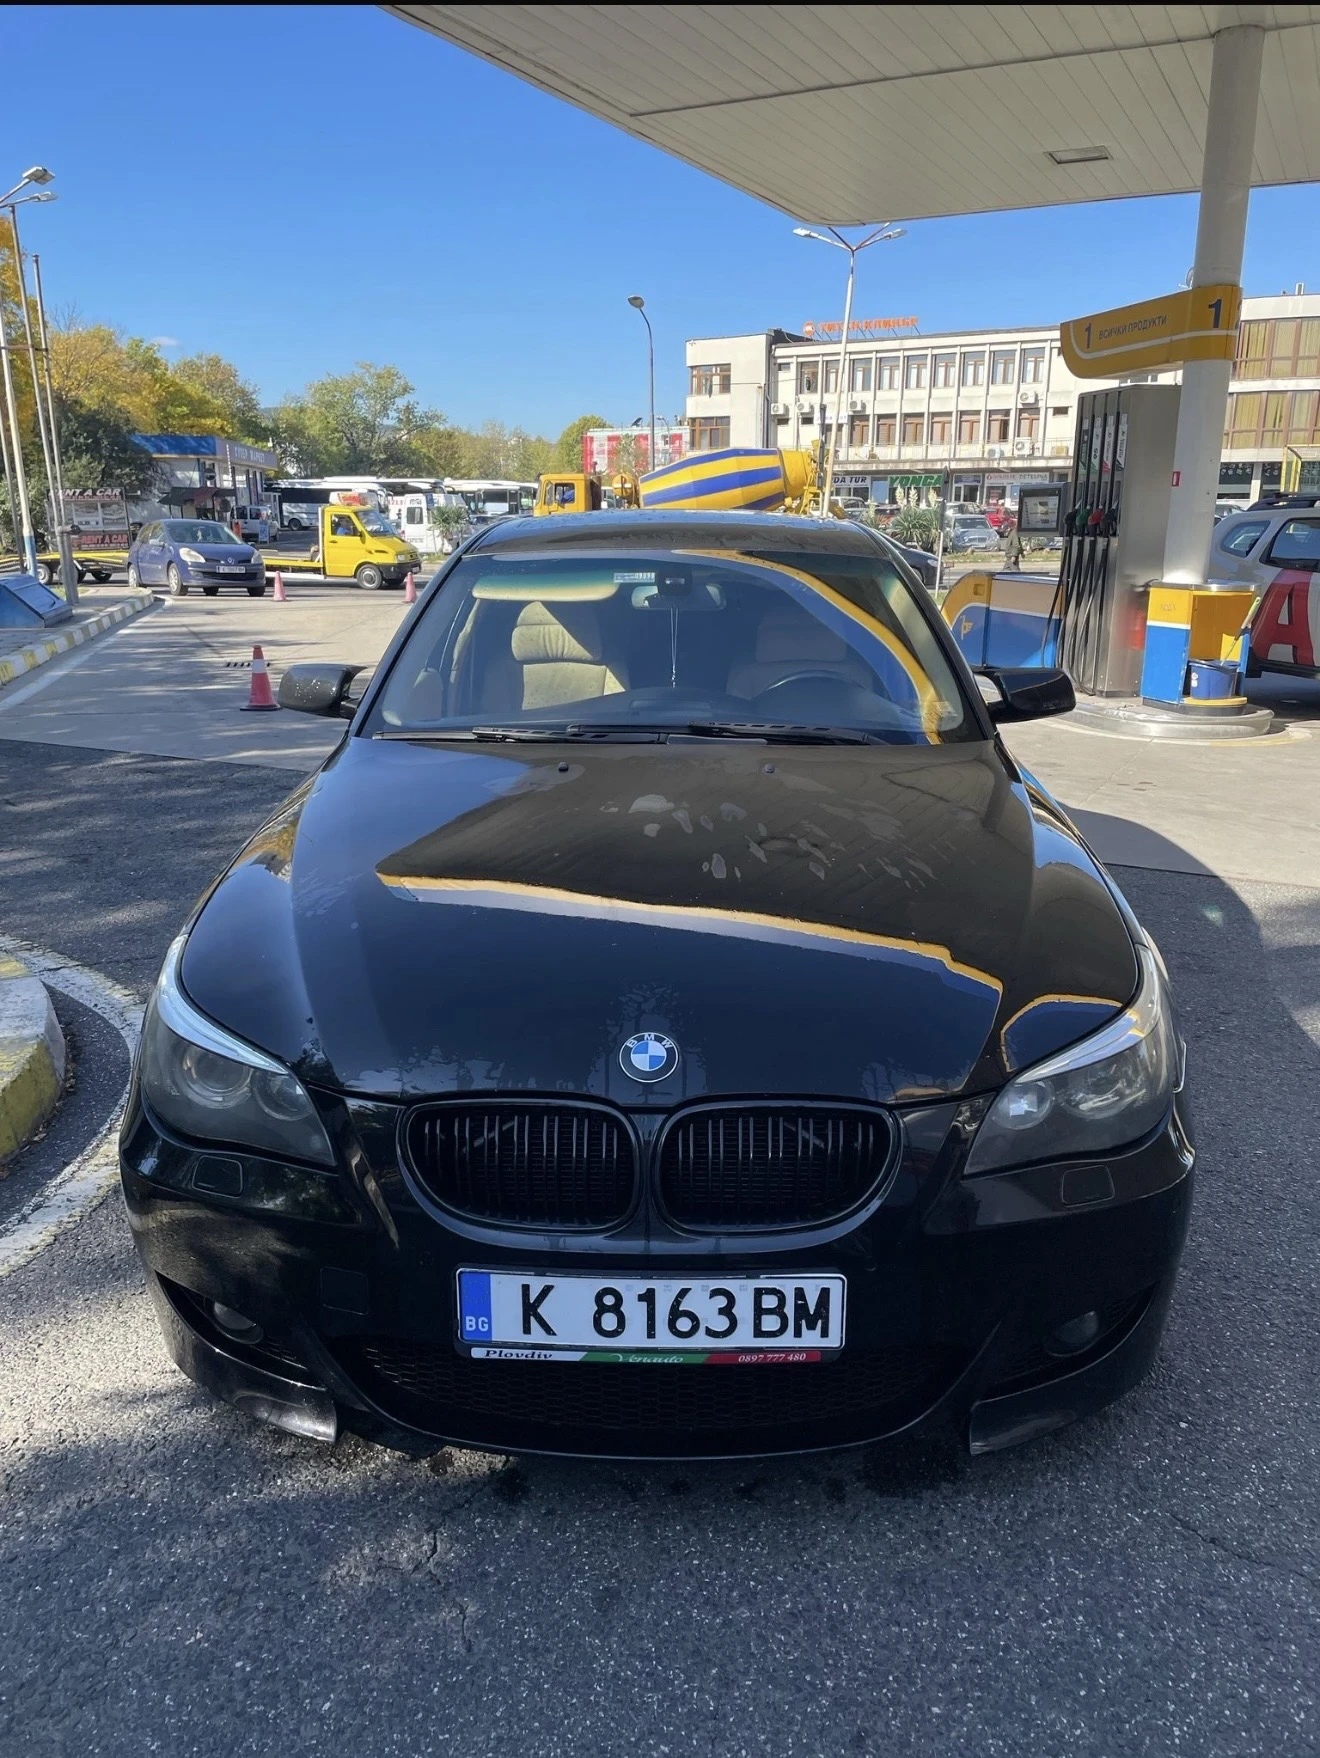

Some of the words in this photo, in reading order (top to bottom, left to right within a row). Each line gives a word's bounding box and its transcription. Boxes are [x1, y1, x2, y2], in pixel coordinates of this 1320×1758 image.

[1208, 298, 1222, 329] 1
[1084, 322, 1092, 349] 1
[1099, 325, 1127, 340] ВСИЧКИ
[1127, 314, 1168, 335] ПРОДУКТИ
[849, 476, 868, 484] TUR
[83, 488, 93, 496] A
[96, 488, 121, 496] CAR
[111, 534, 128, 543] CAR
[521, 1283, 557, 1337] K
[465, 1316, 489, 1332] BG
[485, 1350, 553, 1359] Plovdiv
[738, 1355, 764, 1363] 0897
[765, 1354, 785, 1362] 777
[787, 1353, 807, 1361] 480
